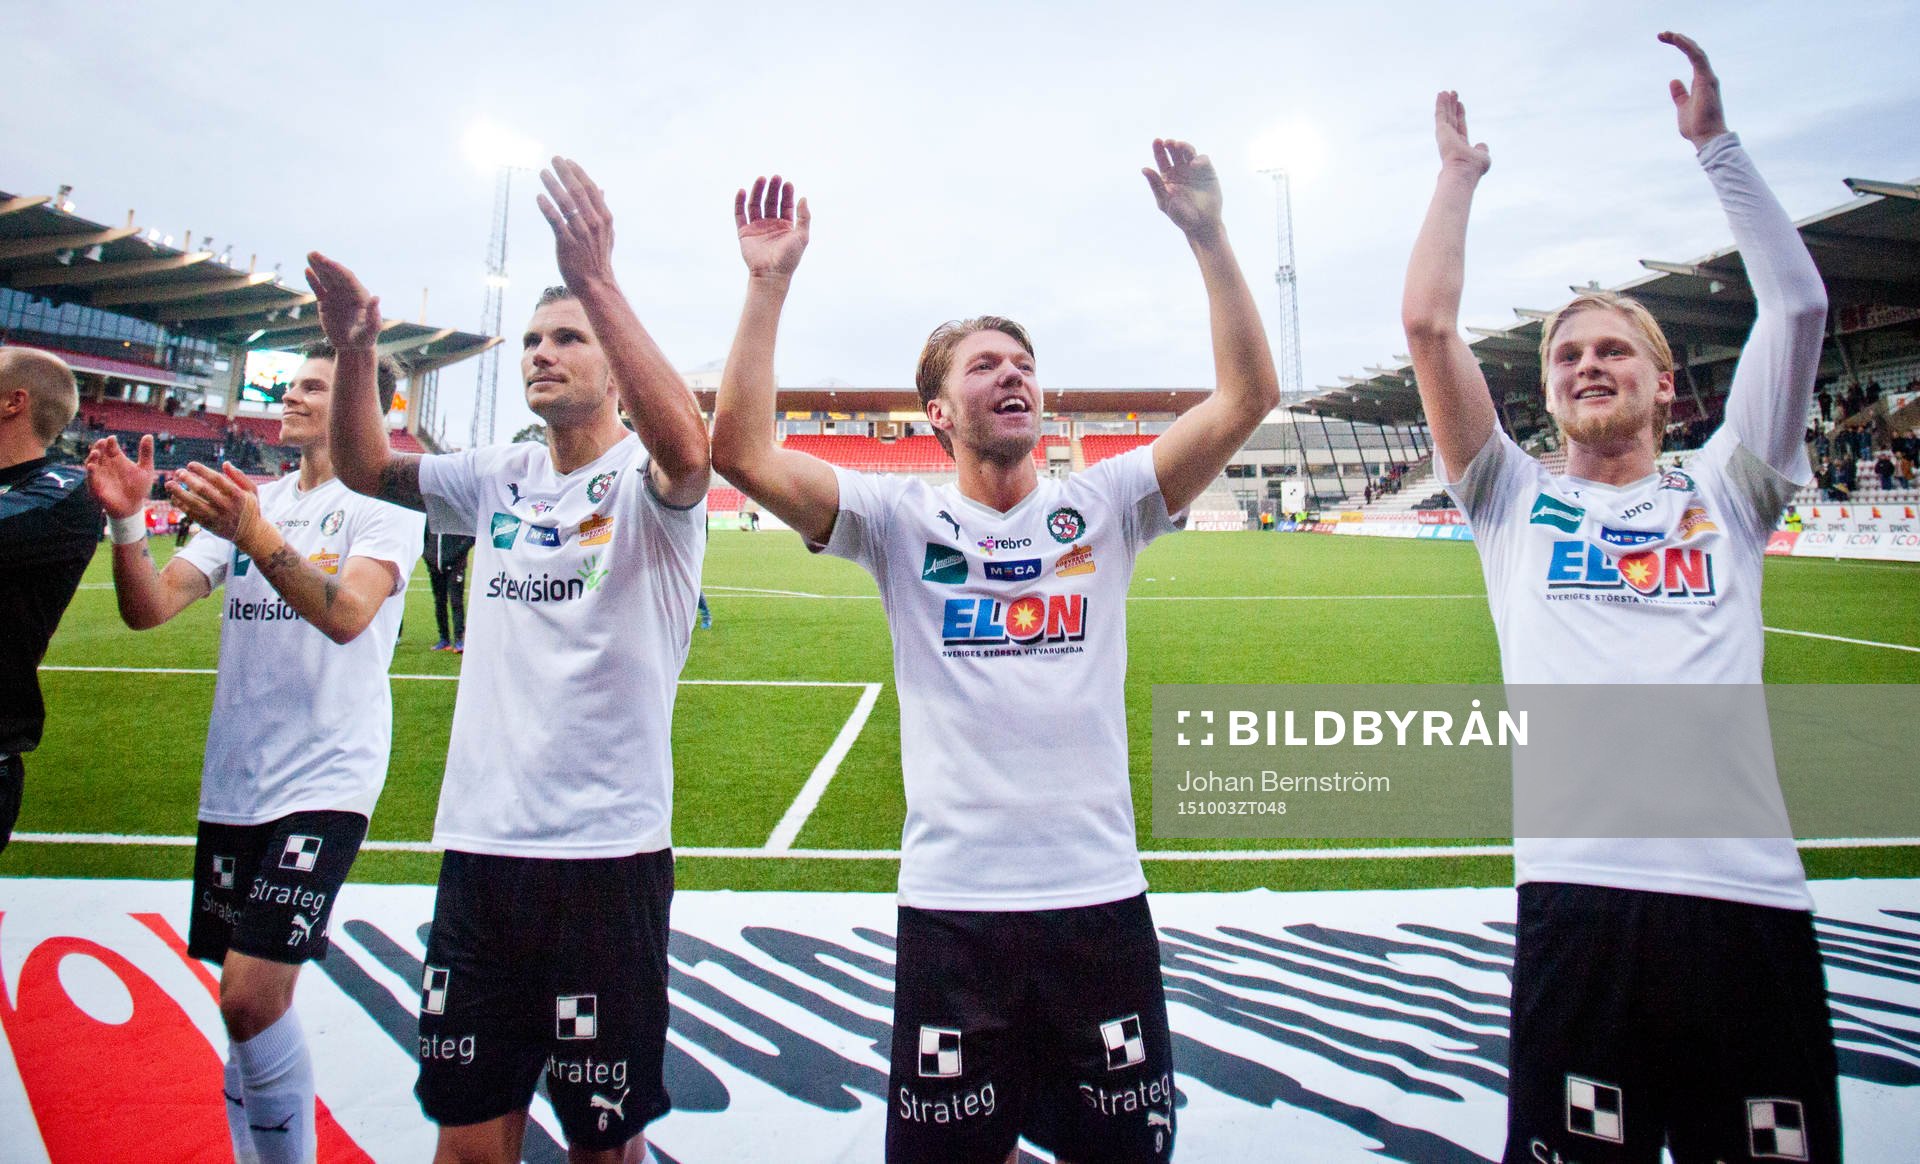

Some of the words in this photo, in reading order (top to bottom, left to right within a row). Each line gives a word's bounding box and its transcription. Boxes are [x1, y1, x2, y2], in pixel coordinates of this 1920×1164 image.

[1804, 532, 1836, 543] ICON
[1846, 533, 1881, 545] ICON
[1546, 540, 1717, 597] ELON
[1594, 594, 1640, 604] STÖRSTA
[941, 594, 1088, 646] ELON
[942, 650, 981, 658] SVERIGES
[983, 649, 1022, 658] STÖRSTA
[250, 878, 326, 916] Strateg
[287, 930, 305, 947] 27
[900, 1083, 995, 1124] Strateg
[597, 1110, 608, 1132] 6
[1155, 1131, 1164, 1153] 9
